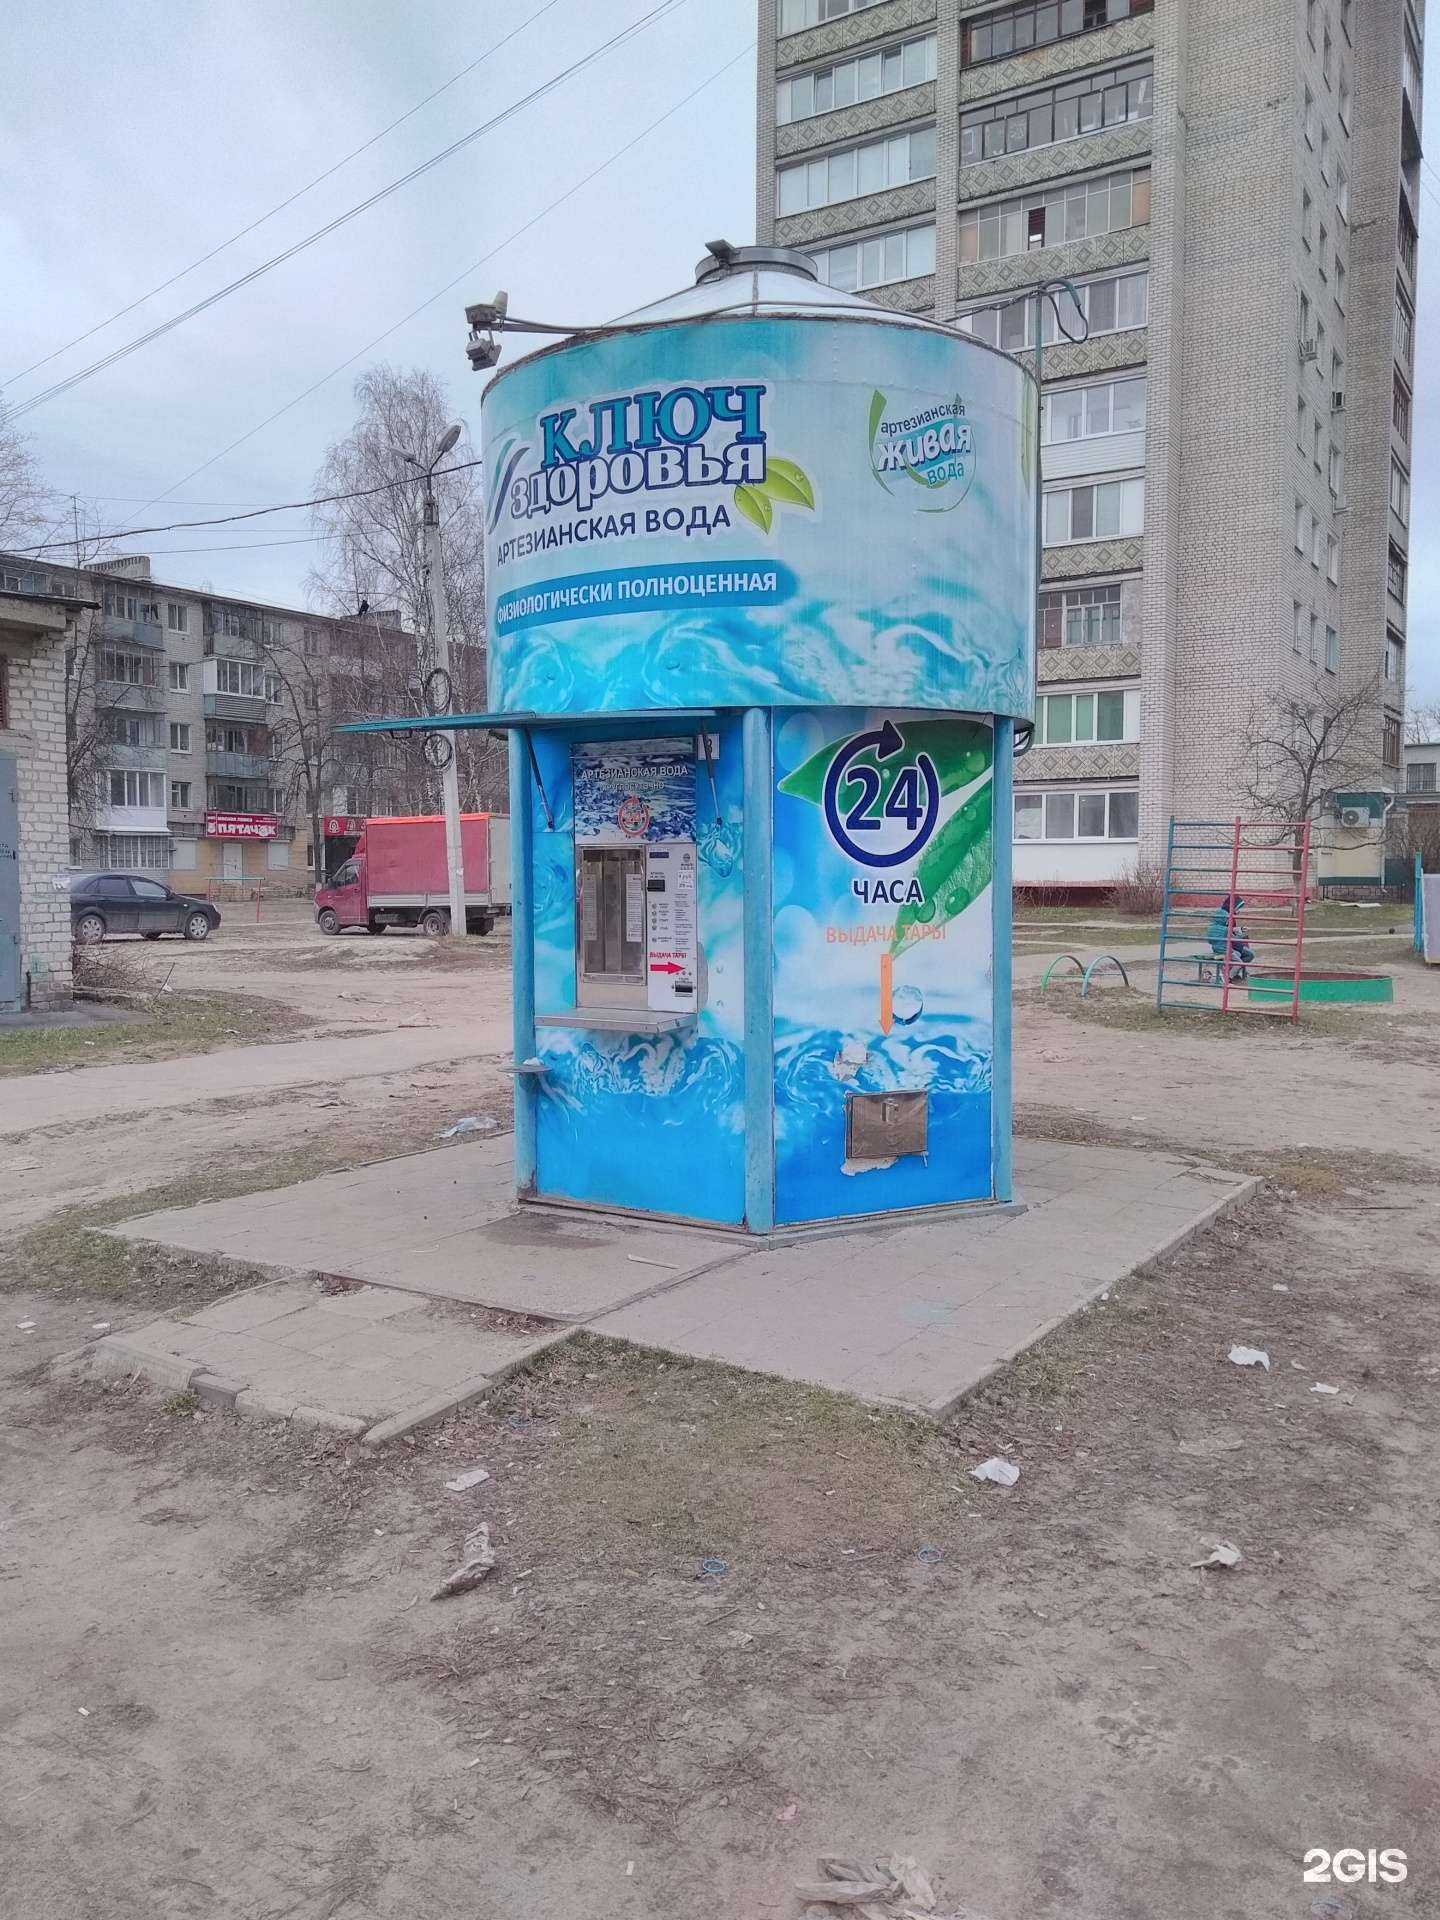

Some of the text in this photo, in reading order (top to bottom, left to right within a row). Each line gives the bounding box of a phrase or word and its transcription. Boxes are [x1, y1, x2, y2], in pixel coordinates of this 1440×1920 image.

[540, 385, 767, 469] КЛЮЧ
[881, 404, 966, 437] артезианская
[927, 462, 965, 485] вода
[497, 504, 731, 567] АРТЕЗИАНСКАЯ ВОДА
[497, 573, 778, 625] ФИЗИОЛОГИЧЕСКИ ПОЛНОЦЕННАЯ
[581, 766, 688, 780] АРТЕЗИАНСКАЯ ВОДА
[845, 766, 924, 831] 24
[853, 879, 924, 904] ЧАСА
[826, 924, 946, 945] ВЫДАЧА ТАРЫ
